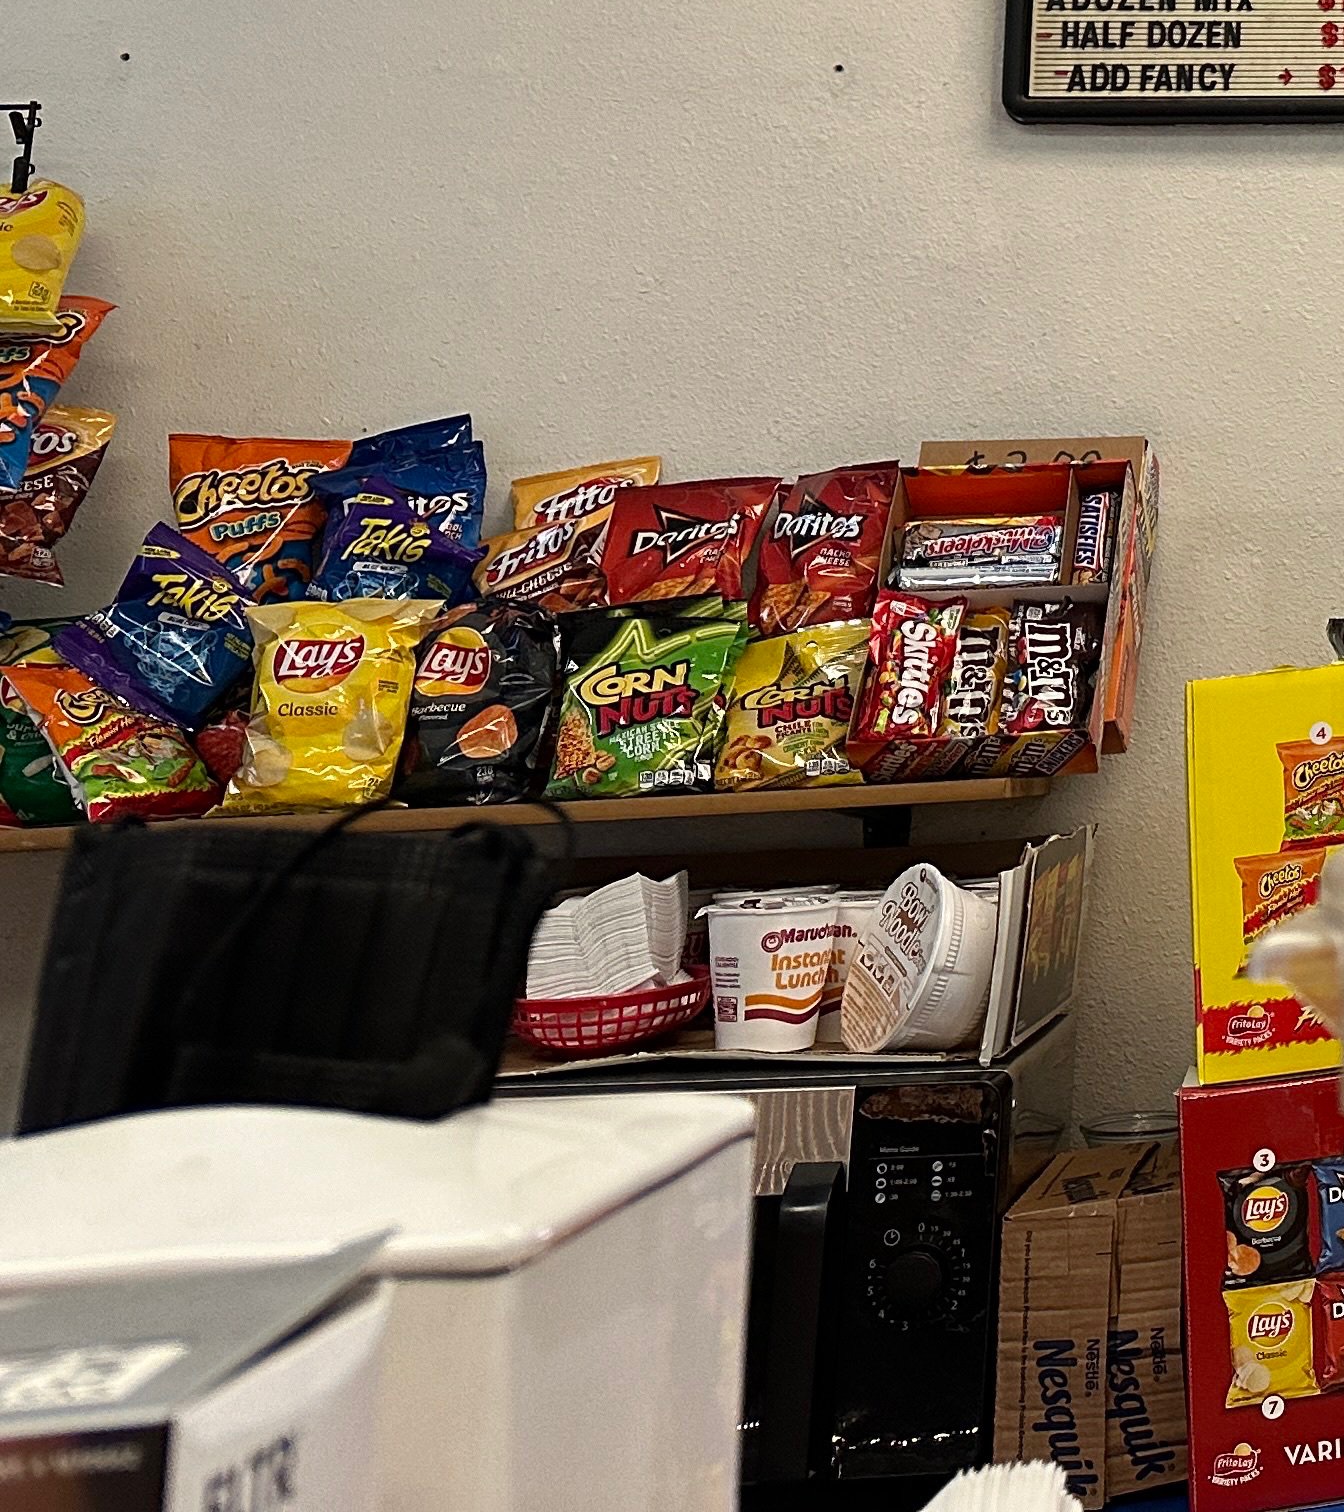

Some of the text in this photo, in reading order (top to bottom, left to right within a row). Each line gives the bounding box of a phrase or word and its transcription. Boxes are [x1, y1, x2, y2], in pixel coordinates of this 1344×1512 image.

[1061, 20, 1135, 49] HALF
[1147, 21, 1242, 49] DOZEN
[1066, 64, 1130, 92] ADD
[1140, 64, 1236, 92] FANCY
[173, 460, 312, 523] Cheetos
[211, 512, 281, 541] Puffs
[341, 514, 431, 562] Takis
[633, 514, 739, 555] Doritos
[774, 512, 863, 540] Doritos
[487, 520, 576, 586] Fritos
[148, 572, 237, 621] Takis
[277, 637, 366, 679] Lay's
[892, 620, 937, 725] Skittles
[580, 663, 687, 705] CORN
[277, 701, 339, 719] Classic
[598, 687, 696, 735] NUTS
[1107, 1329, 1175, 1480] Nesquik
